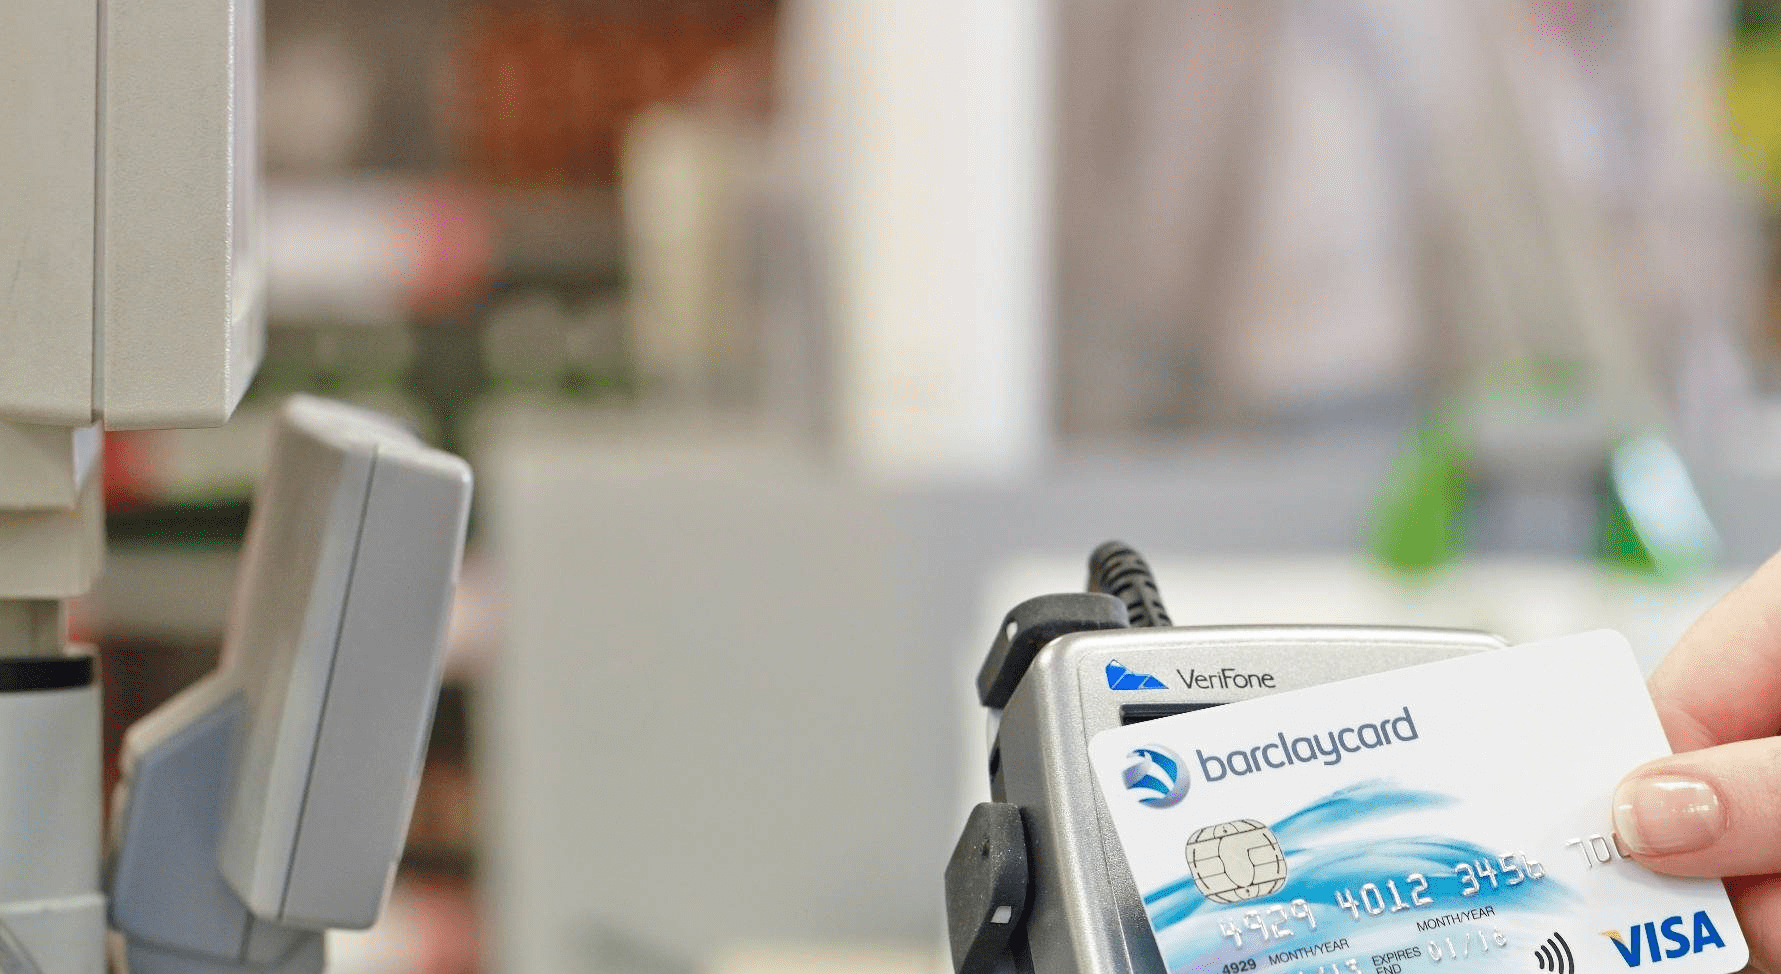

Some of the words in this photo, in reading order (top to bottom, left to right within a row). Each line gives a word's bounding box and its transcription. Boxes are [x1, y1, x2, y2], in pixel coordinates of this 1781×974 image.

[1176, 667, 1276, 690] VeriFone
[1196, 706, 1419, 783] barclaycard
[1219, 898, 1319, 950] 4929
[1334, 873, 1434, 920] 4012
[1454, 850, 1546, 898] 3456
[1416, 904, 1496, 932] MONTH/YEAR
[1268, 938, 1350, 966] MONTH/YEAR
[1600, 910, 1726, 968] VISA
[1371, 946, 1422, 968] EXPIRES
